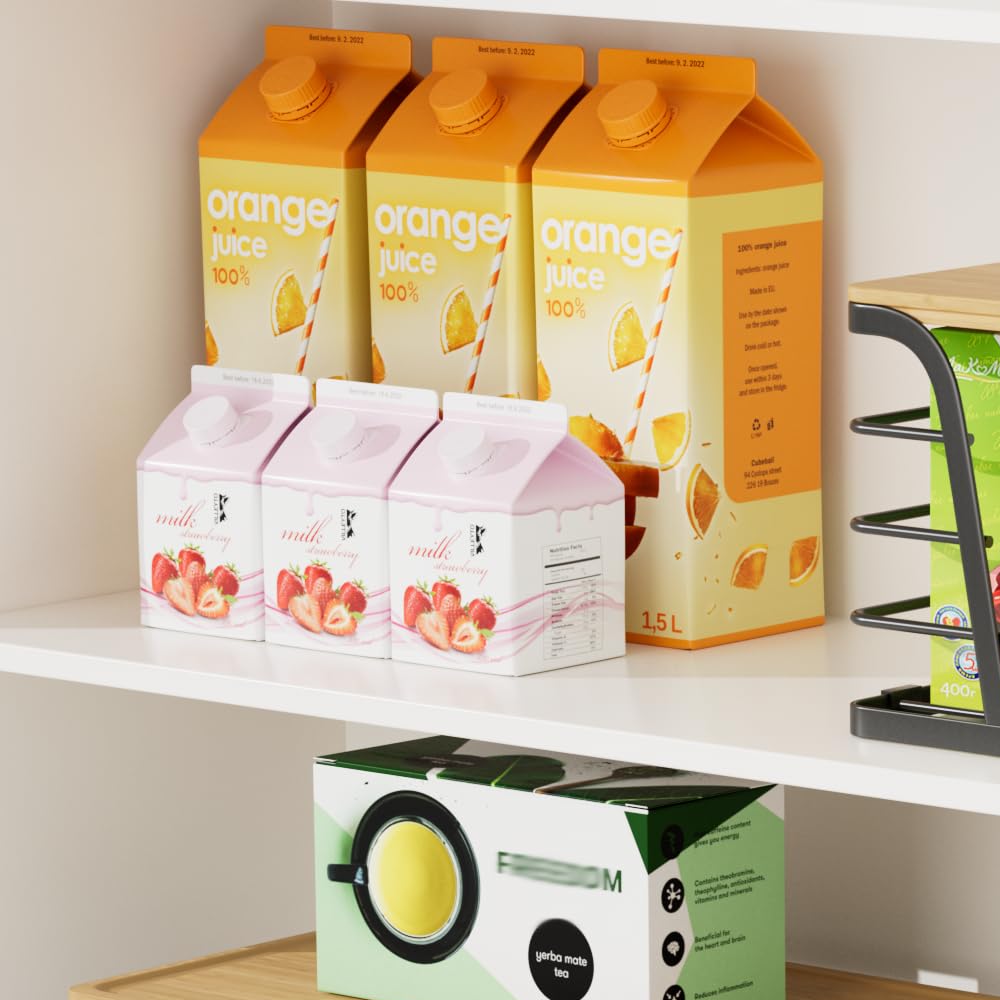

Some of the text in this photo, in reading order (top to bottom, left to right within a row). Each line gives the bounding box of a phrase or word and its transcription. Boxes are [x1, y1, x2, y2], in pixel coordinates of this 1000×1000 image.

[520, 48, 536, 56] 2022
[689, 59, 705, 68] 2022
[207, 189, 331, 236] orange
[375, 203, 504, 251] orange
[210, 226, 268, 261] juice
[541, 218, 675, 267] orange
[378, 241, 437, 277] juice
[212, 265, 250, 286] 100%
[544, 256, 605, 293] juice
[379, 281, 419, 304] 100%
[546, 297, 586, 319] 100%
[155, 498, 206, 528] milk
[180, 528, 232, 552] strawberry
[281, 514, 333, 544] milk
[305, 543, 361, 568] strawberry
[408, 530, 463, 560] milk
[434, 559, 489, 585] strawberry
[642, 611, 682, 633] 1,5 L
[709, 838, 720, 846] you
[720, 833, 740, 841] energy
[694, 877, 719, 887] Contains
[694, 895, 718, 904] vitamins
[730, 887, 753, 896] minerals
[694, 930, 722, 943] Beneficial
[704, 941, 719, 949] heart
[720, 938, 730, 946] and
[731, 935, 746, 943] brain
[535, 949, 588, 967] yerba mate
[554, 967, 570, 979] tea
[694, 981, 754, 1000] Reduces inflammation
